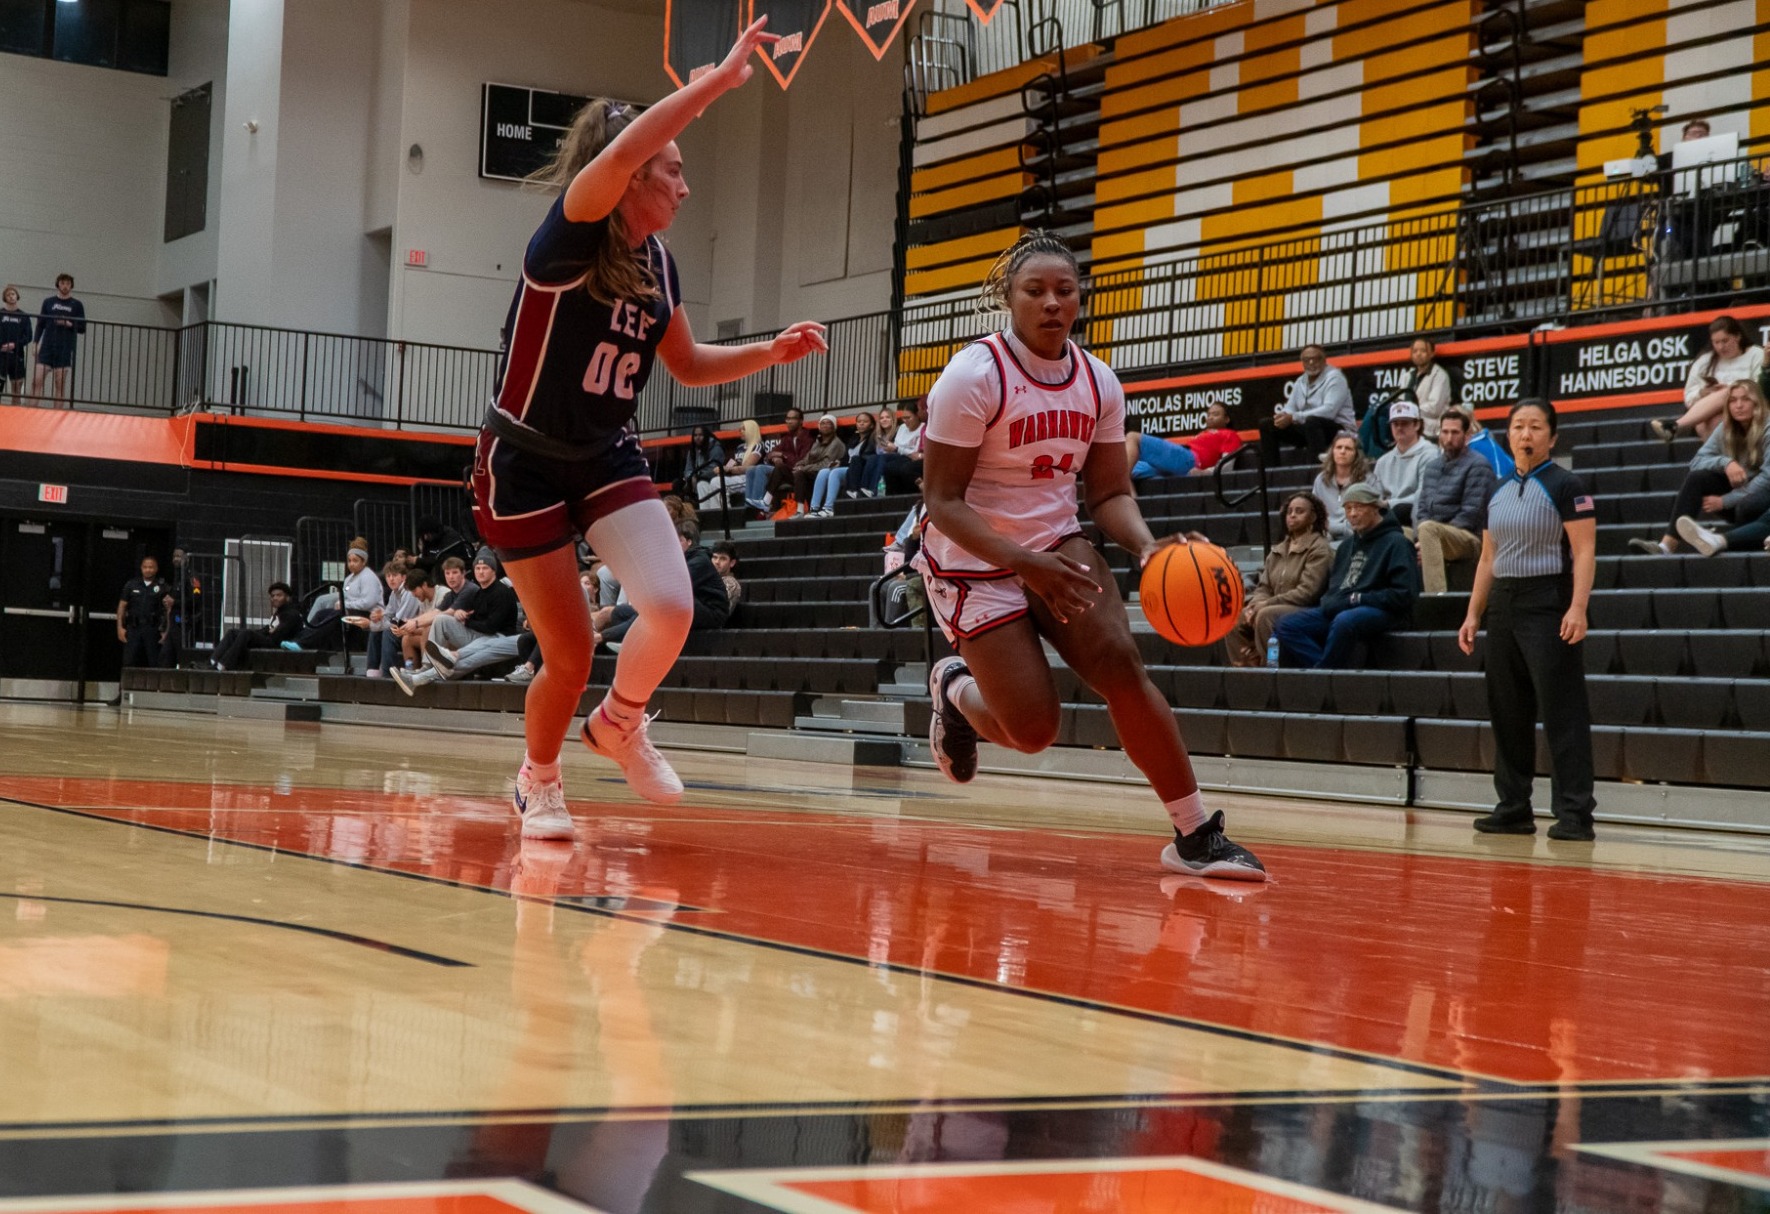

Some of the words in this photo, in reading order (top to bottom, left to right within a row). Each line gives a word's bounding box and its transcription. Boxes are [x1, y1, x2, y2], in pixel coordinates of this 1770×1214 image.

[496, 122, 533, 141] HOME
[409, 248, 426, 264] EXIT
[610, 298, 657, 342] LEE
[1578, 340, 1643, 368] HELGA
[1646, 334, 1690, 359] OSK
[1463, 354, 1520, 380] STEVE
[1560, 359, 1692, 394] HANNESDOTT
[1126, 393, 1182, 416] NICOLAS
[1184, 387, 1243, 411] PINONES
[1461, 379, 1520, 403] CROTZ
[1008, 409, 1096, 450] WARHAWKS
[44, 485, 64, 502] EXIT
